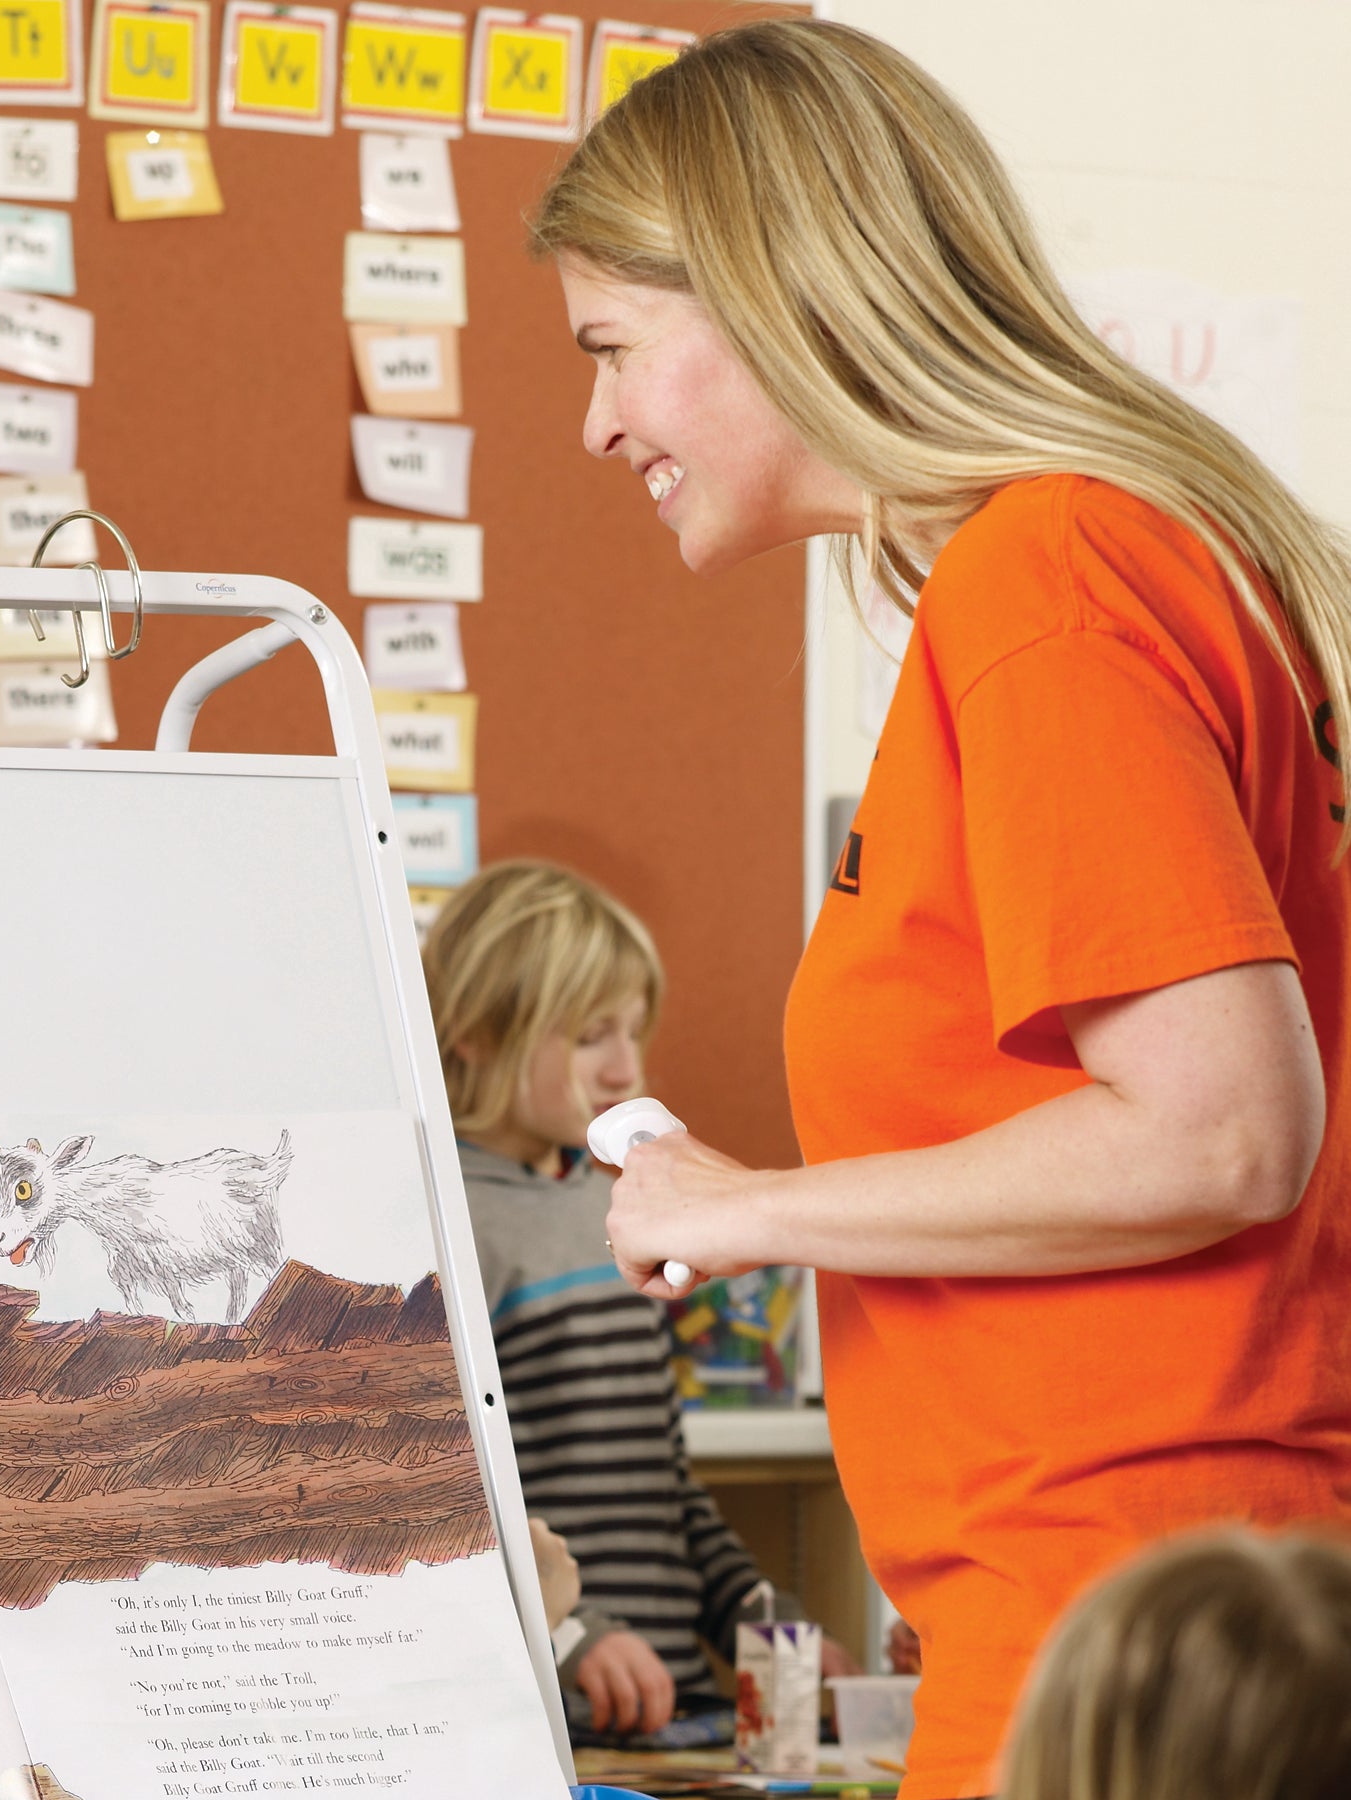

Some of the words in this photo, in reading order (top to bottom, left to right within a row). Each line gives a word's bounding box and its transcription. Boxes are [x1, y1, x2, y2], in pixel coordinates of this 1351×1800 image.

[0, 9, 43, 58] Tt
[123, 28, 177, 82] Uu
[256, 37, 304, 87] Vv
[365, 42, 445, 93] Ww
[498, 46, 550, 95] Xx
[10, 147, 47, 177] to
[386, 169, 423, 184] we
[365, 263, 442, 284] where
[383, 359, 432, 377] who
[1, 420, 52, 446] two
[386, 452, 424, 474] will
[382, 545, 451, 576] was
[195, 582, 237, 594] Copernicus
[385, 631, 439, 654] with
[388, 731, 445, 753] what
[110, 1596, 140, 1611] “Oh,
[143, 1596, 160, 1609] it’s
[163, 1596, 188, 1611] only
[192, 1594, 202, 1609] I,
[204, 1593, 224, 1606] the
[226, 1592, 262, 1606] tiniest
[264, 1589, 293, 1606] Billy
[297, 1588, 326, 1602] Goat
[330, 1585, 374, 1600] Gruff,”
[115, 1621, 137, 1635] said
[139, 1620, 158, 1634] the
[160, 1619, 188, 1636] Billy
[191, 1618, 222, 1632] Goat
[224, 1616, 237, 1630] in
[239, 1614, 257, 1629] his
[259, 1616, 285, 1630] very
[289, 1611, 319, 1626] small
[322, 1610, 357, 1624] voice.
[120, 1644, 154, 1659] “And
[156, 1643, 178, 1657] I’m
[181, 1642, 215, 1660] going
[216, 1642, 229, 1655] to
[231, 1639, 250, 1653] the
[253, 1638, 301, 1652] meadow
[306, 1638, 319, 1649] to
[322, 1634, 353, 1648] make
[356, 1630, 394, 1649] myself
[397, 1628, 424, 1643] fat.”
[129, 1680, 157, 1694] “No
[160, 1677, 199, 1696] you’re
[202, 1675, 231, 1690] not,”
[235, 1675, 257, 1689] said
[259, 1673, 279, 1687] the
[280, 1671, 317, 1686] Troll,
[136, 1703, 162, 1717] “for
[164, 1702, 185, 1716] I’m
[188, 1700, 232, 1716] coming
[233, 1700, 247, 1711] to
[249, 1697, 287, 1714] gobble
[290, 1698, 313, 1713] you
[315, 1693, 342, 1711] up!”
[147, 1738, 178, 1752] “Oh,
[180, 1738, 215, 1754] please
[218, 1733, 249, 1748] don’t
[252, 1731, 277, 1745] take
[280, 1733, 302, 1744] me.
[305, 1729, 326, 1742] I’m
[329, 1731, 350, 1741] too
[353, 1727, 383, 1740] little,
[386, 1724, 410, 1737] that
[412, 1723, 419, 1736] I
[423, 1721, 449, 1735] am,”
[155, 1761, 178, 1774] said
[179, 1760, 198, 1773] the
[199, 1758, 227, 1774] Billy
[230, 1757, 266, 1770] Goat.
[266, 1754, 304, 1768] “Wait
[306, 1752, 324, 1765] till
[326, 1751, 345, 1764] the
[346, 1749, 385, 1762] second
[163, 1783, 190, 1799] Billy
[193, 1782, 223, 1794] Goat
[224, 1779, 258, 1793] Gruff
[301, 1775, 331, 1789] He’s
[332, 1773, 365, 1787] much
[367, 1769, 412, 1787] bigger.”
